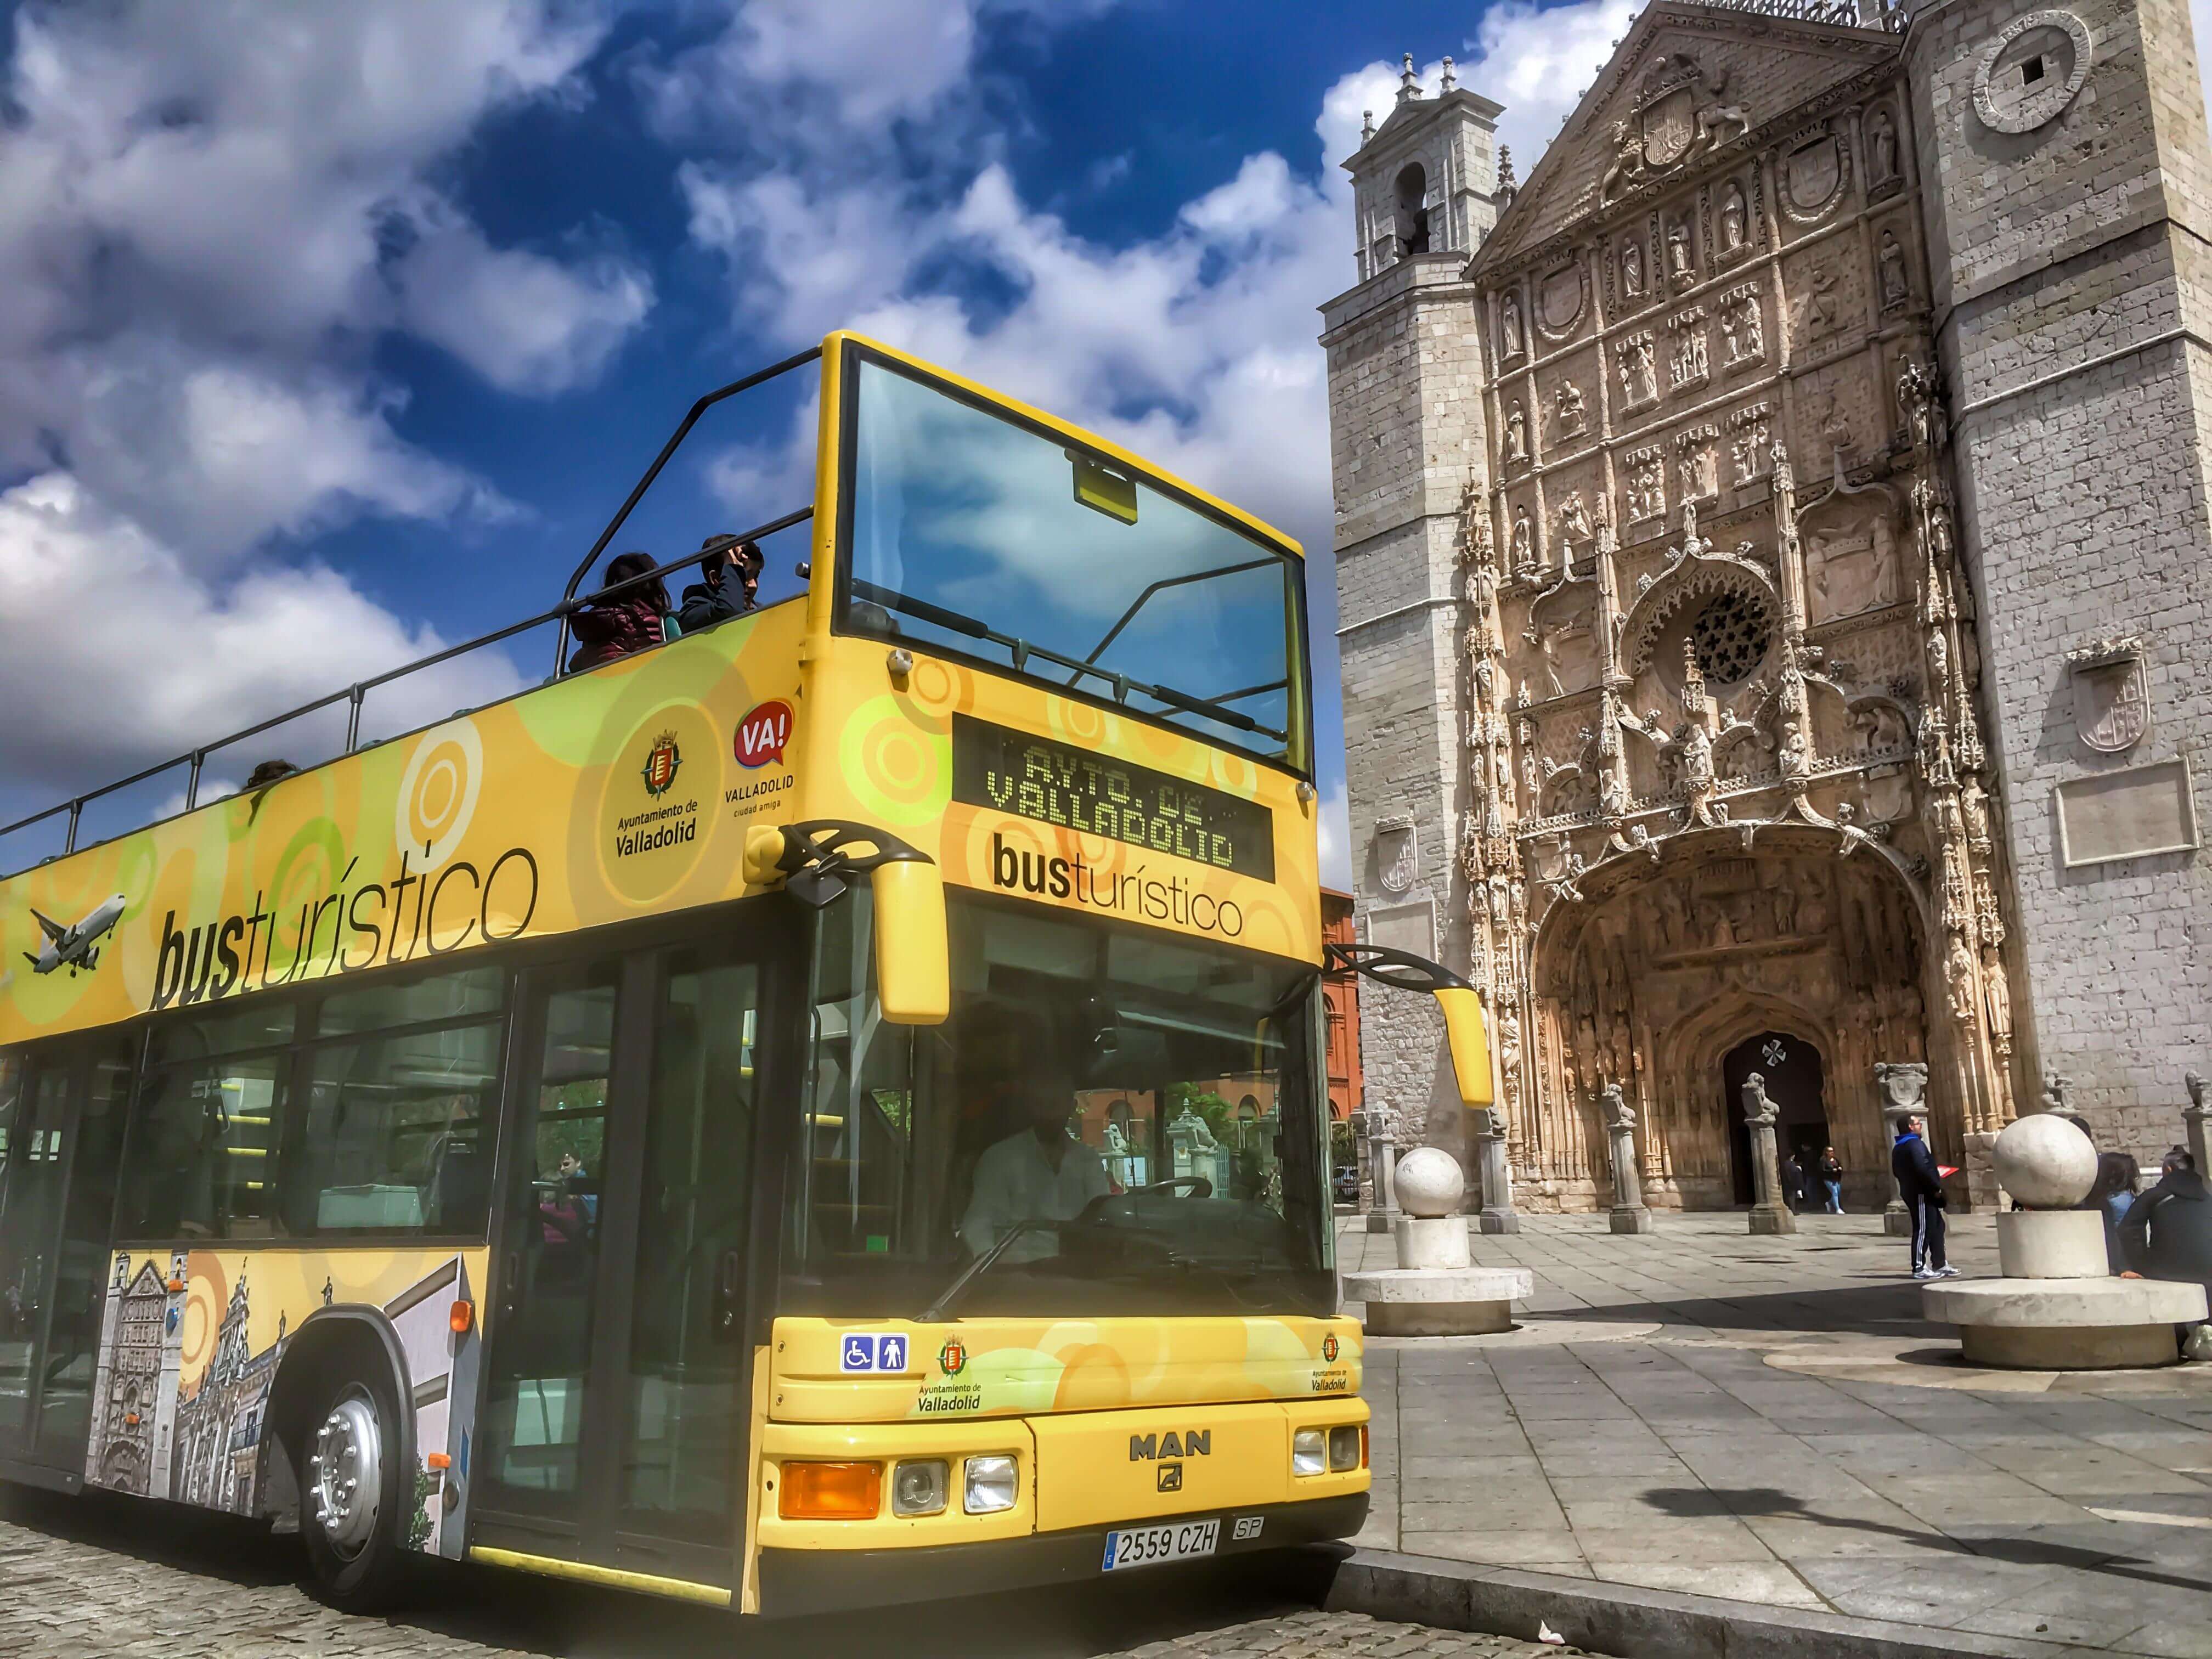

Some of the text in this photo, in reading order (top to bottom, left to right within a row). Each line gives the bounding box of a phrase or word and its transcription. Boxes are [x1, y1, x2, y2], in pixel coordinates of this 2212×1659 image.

[743, 713, 785, 755] VA!
[725, 775, 793, 803] VALLADOLID
[618, 799, 698, 832] Ayuntamiento de
[734, 800, 781, 817] ciudad amiga
[988, 771, 1232, 867] VALLADOLID
[616, 817, 696, 857] Valladolid
[993, 833, 1243, 936] busturístico
[150, 839, 538, 1011] busturístico
[919, 1383, 981, 1396] Ayuntamiento de
[1312, 1378, 1346, 1391] Valladolid
[918, 1394, 980, 1412] Valladolid
[1130, 1429, 1211, 1461] MAN
[1119, 1523, 1216, 1563] 2559 CZH
[1237, 1519, 1261, 1537] SP
